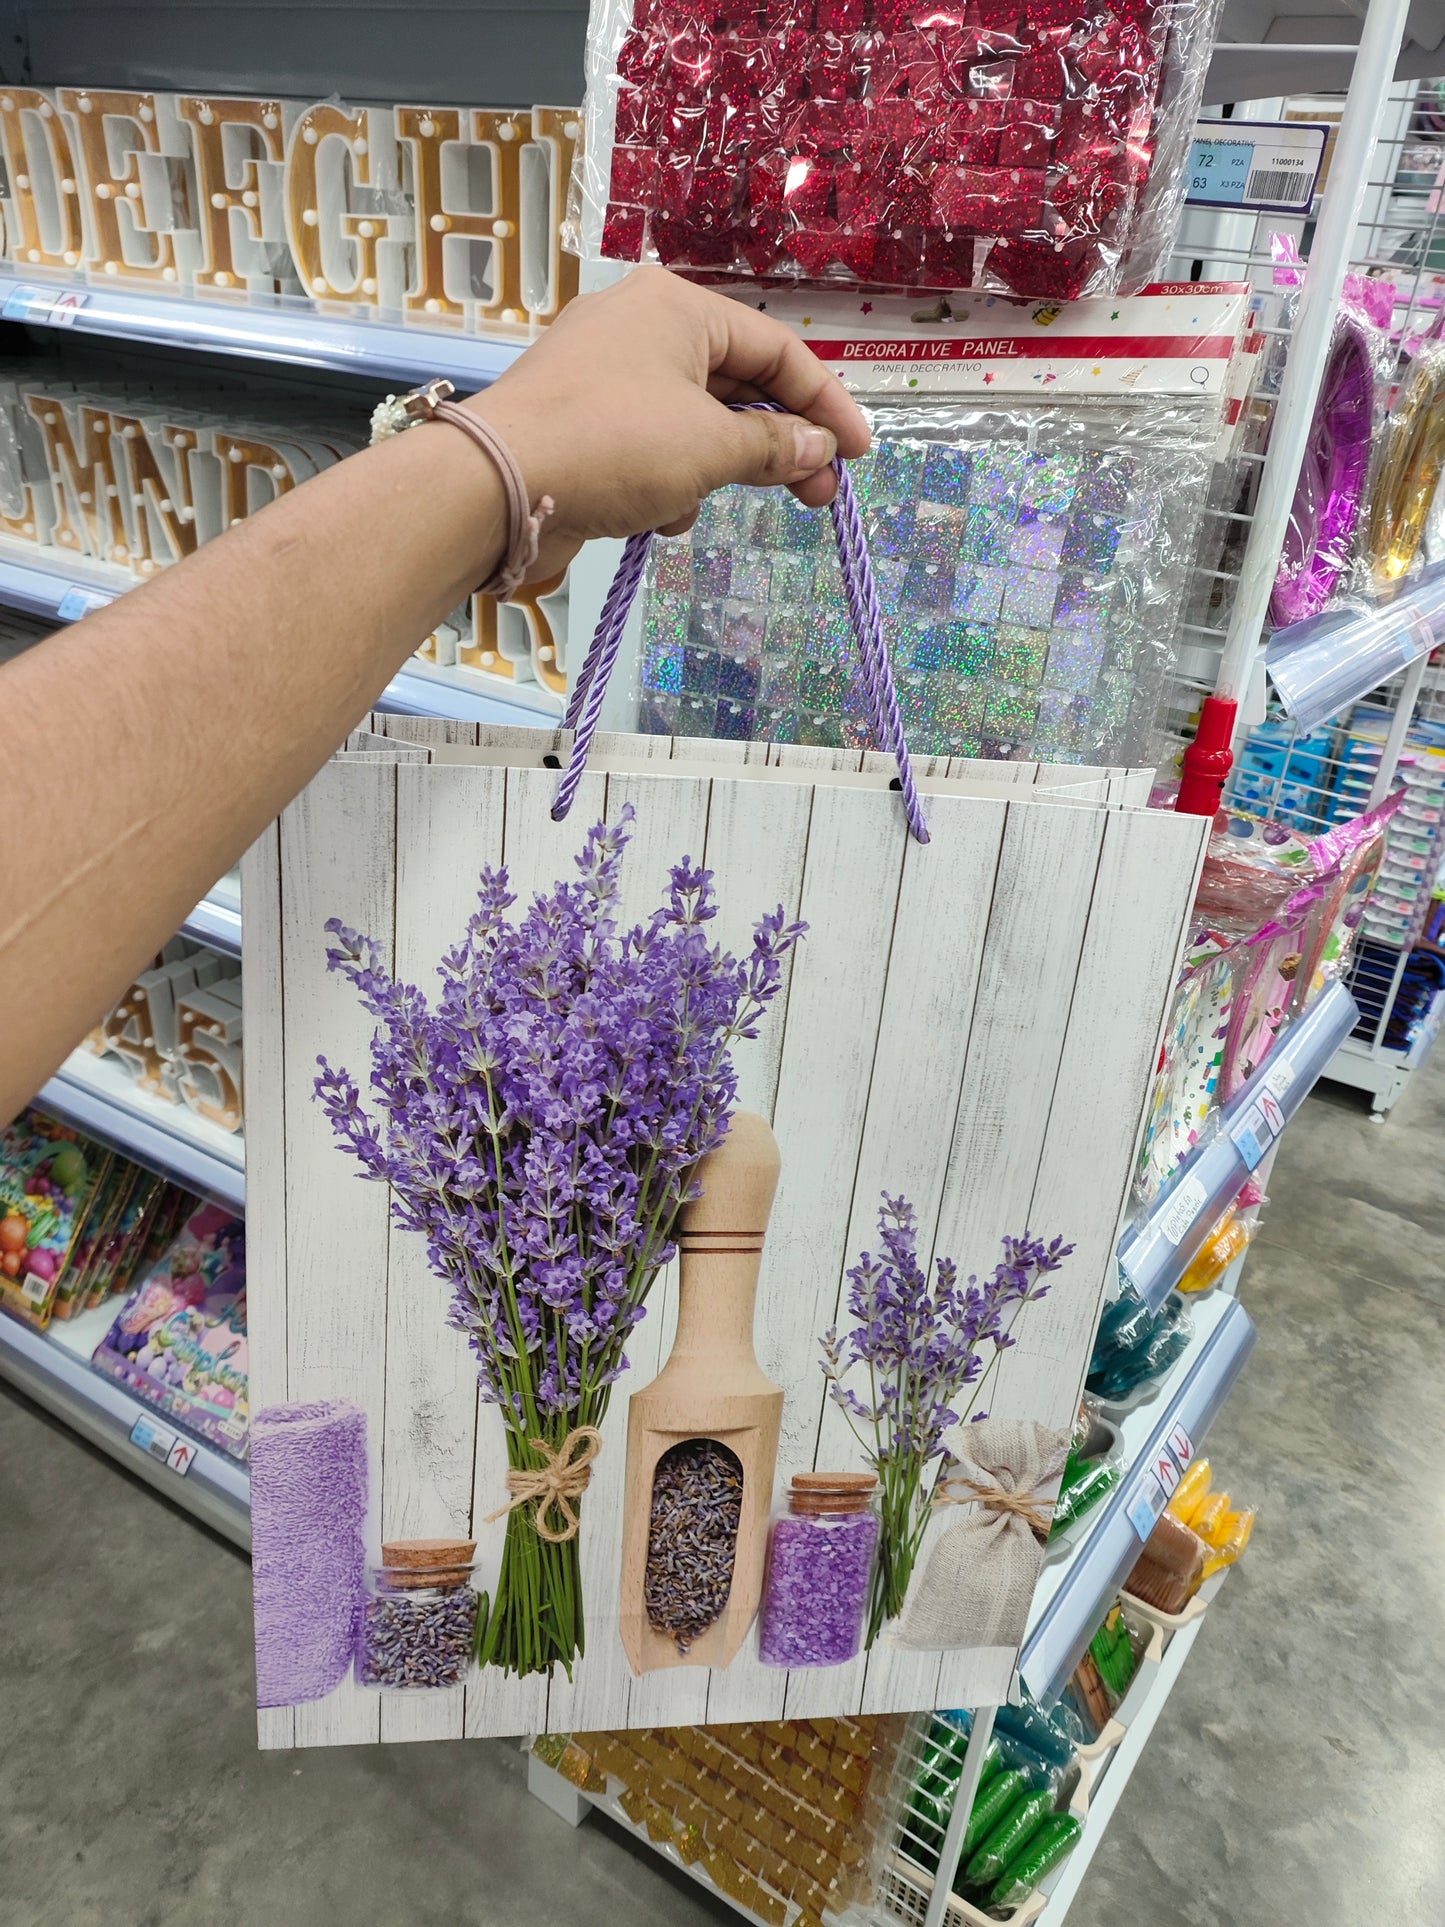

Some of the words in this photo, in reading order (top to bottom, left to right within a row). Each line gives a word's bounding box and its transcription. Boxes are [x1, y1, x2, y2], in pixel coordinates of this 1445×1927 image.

[1231, 158, 1245, 166] PZA
[1271, 157, 1304, 166] 11000134
[1192, 177, 1207, 189] 63
[1231, 180, 1245, 189] PZA
[1160, 285, 1224, 294] 30x30cm
[843, 341, 953, 357] DECORATIVE
[961, 340, 1018, 356] PANEL
[872, 363, 906, 373] PANEL
